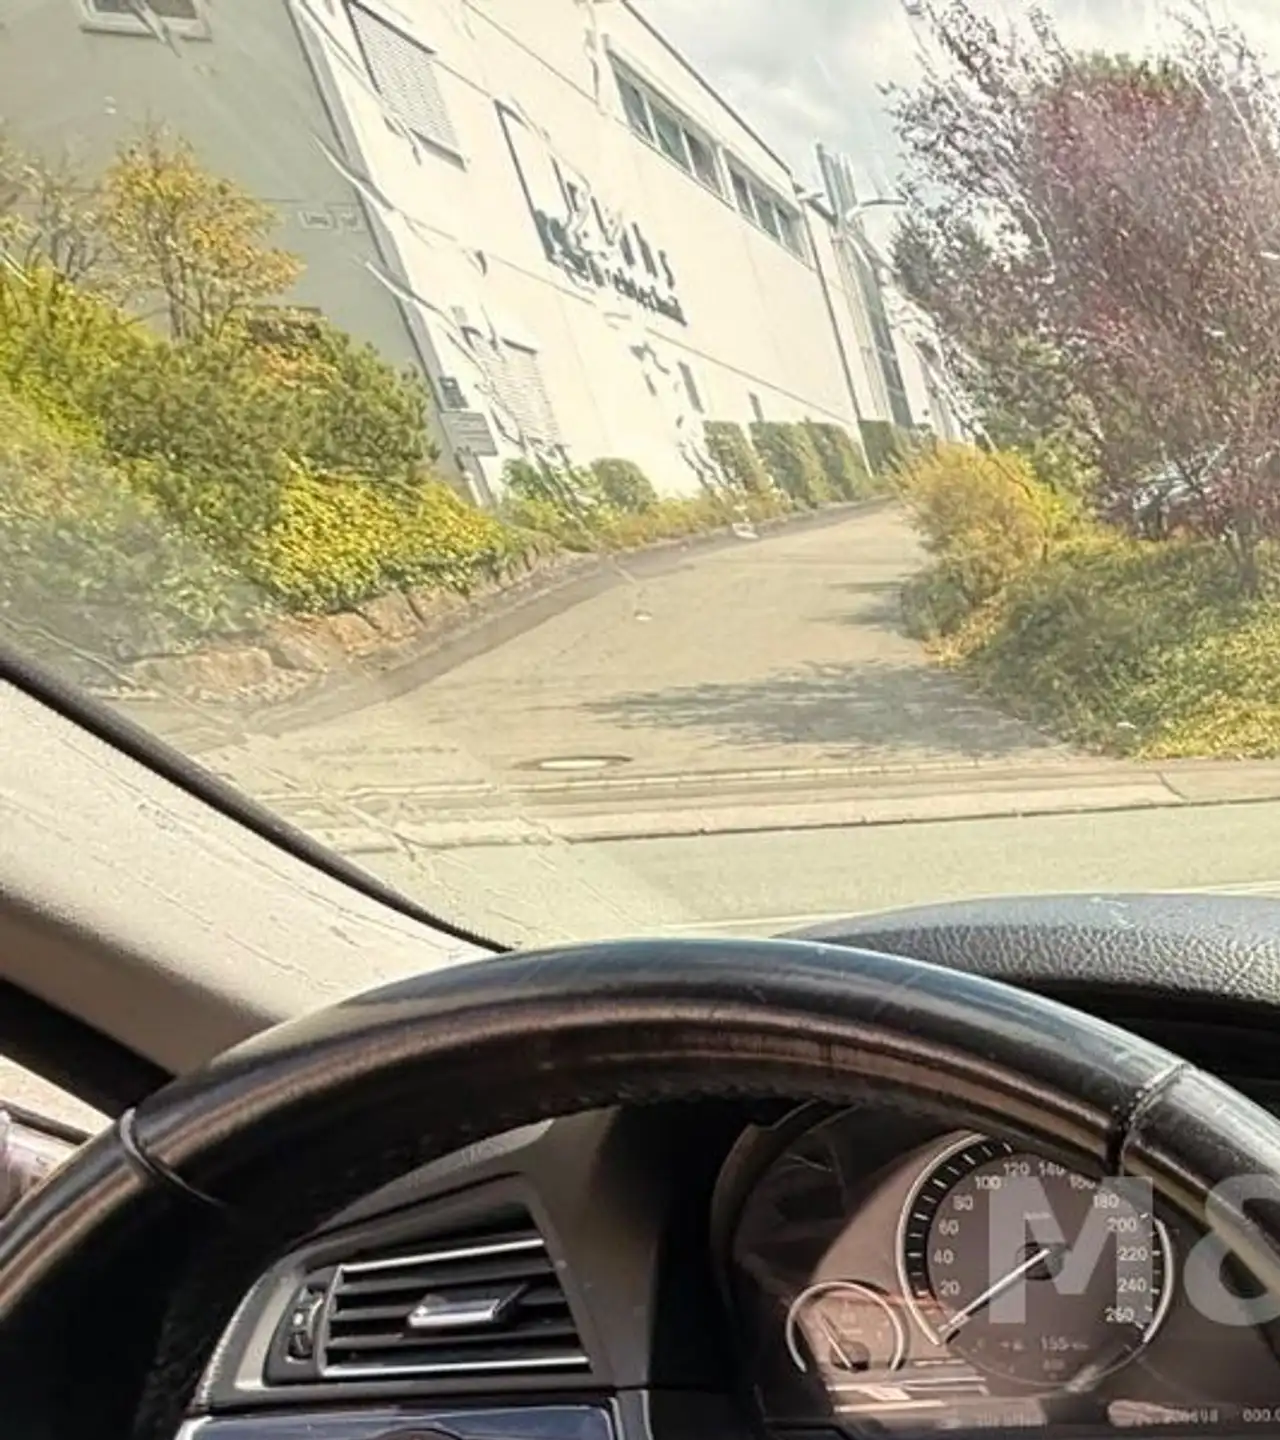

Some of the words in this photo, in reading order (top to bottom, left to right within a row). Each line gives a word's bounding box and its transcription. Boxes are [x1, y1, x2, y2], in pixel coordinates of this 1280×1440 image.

[1004, 1162, 1030, 1177] 120
[975, 1175, 1002, 1190] 100
[953, 1196, 974, 1212] 80
[1093, 1194, 1120, 1209] 180
[938, 1219, 960, 1235] 60
[1107, 1216, 1138, 1232] 200
[933, 1250, 954, 1265] 40
[1118, 1247, 1148, 1262] 220
[940, 1280, 961, 1296] 20
[1117, 1277, 1146, 1293] 240
[1104, 1306, 1135, 1323] 260
